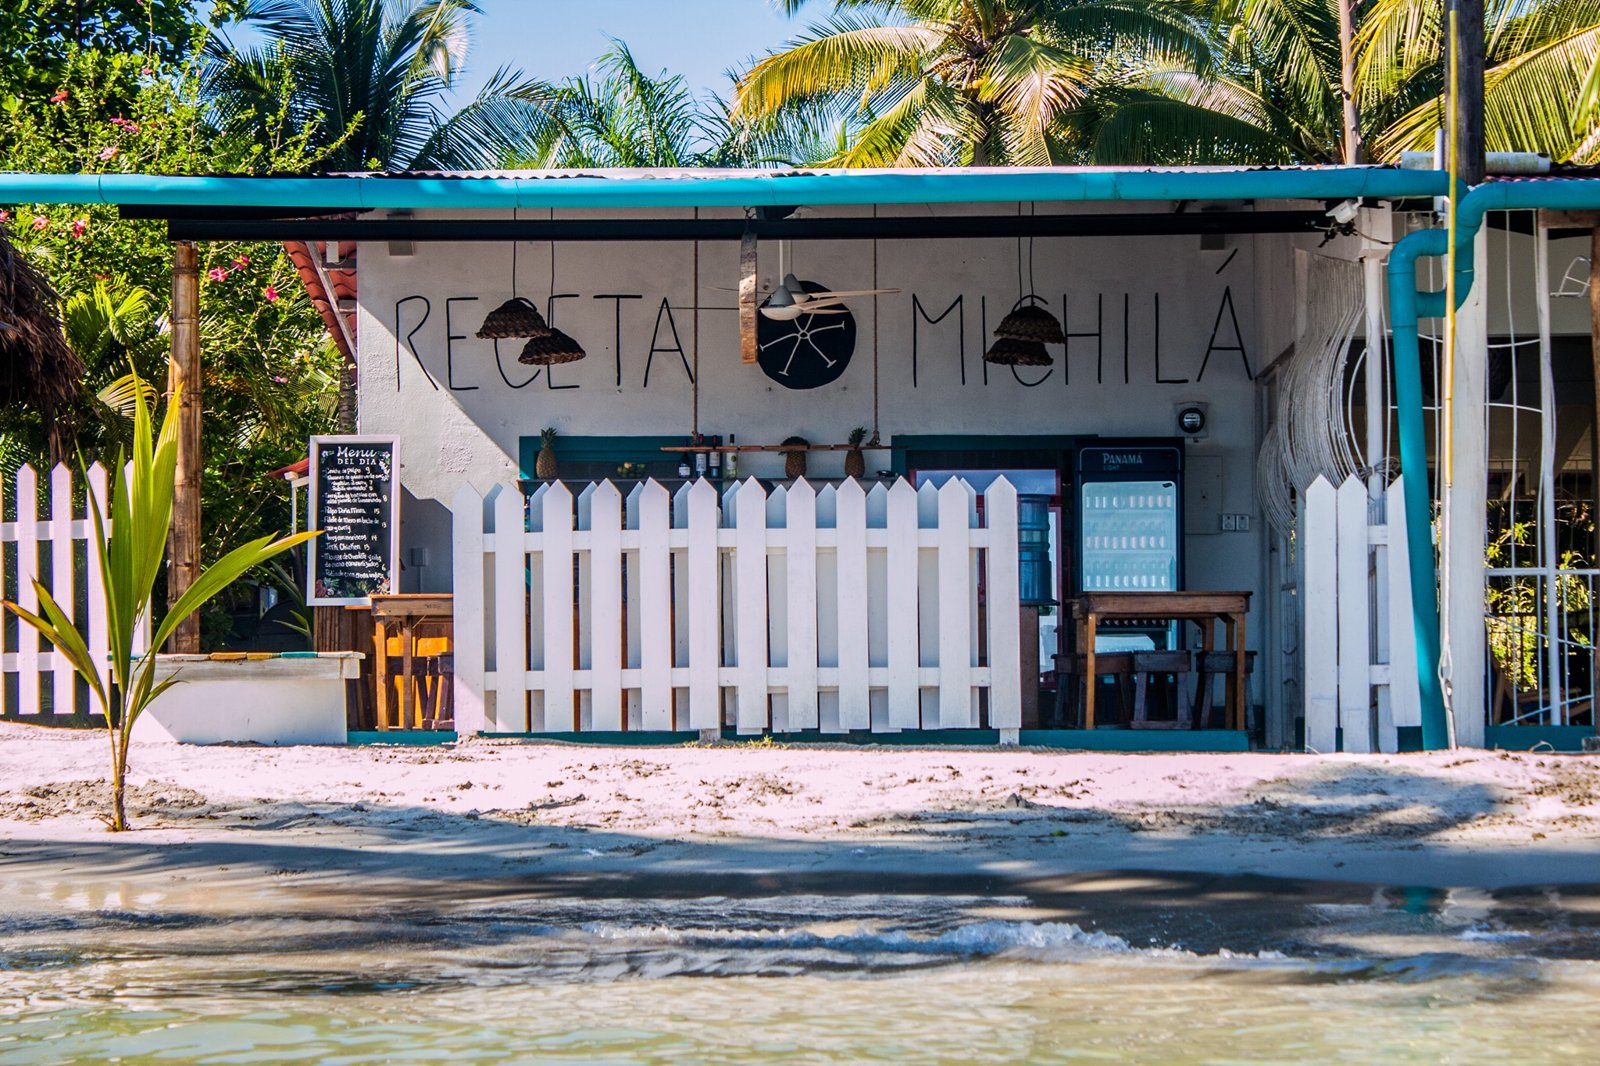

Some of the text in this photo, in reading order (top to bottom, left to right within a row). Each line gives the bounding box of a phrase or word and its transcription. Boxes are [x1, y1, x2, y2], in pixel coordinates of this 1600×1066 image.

[395, 249, 1253, 392] RECETA MICHILÁ
[337, 446, 377, 458] Menu
[1102, 452, 1143, 464] PANAMÁ
